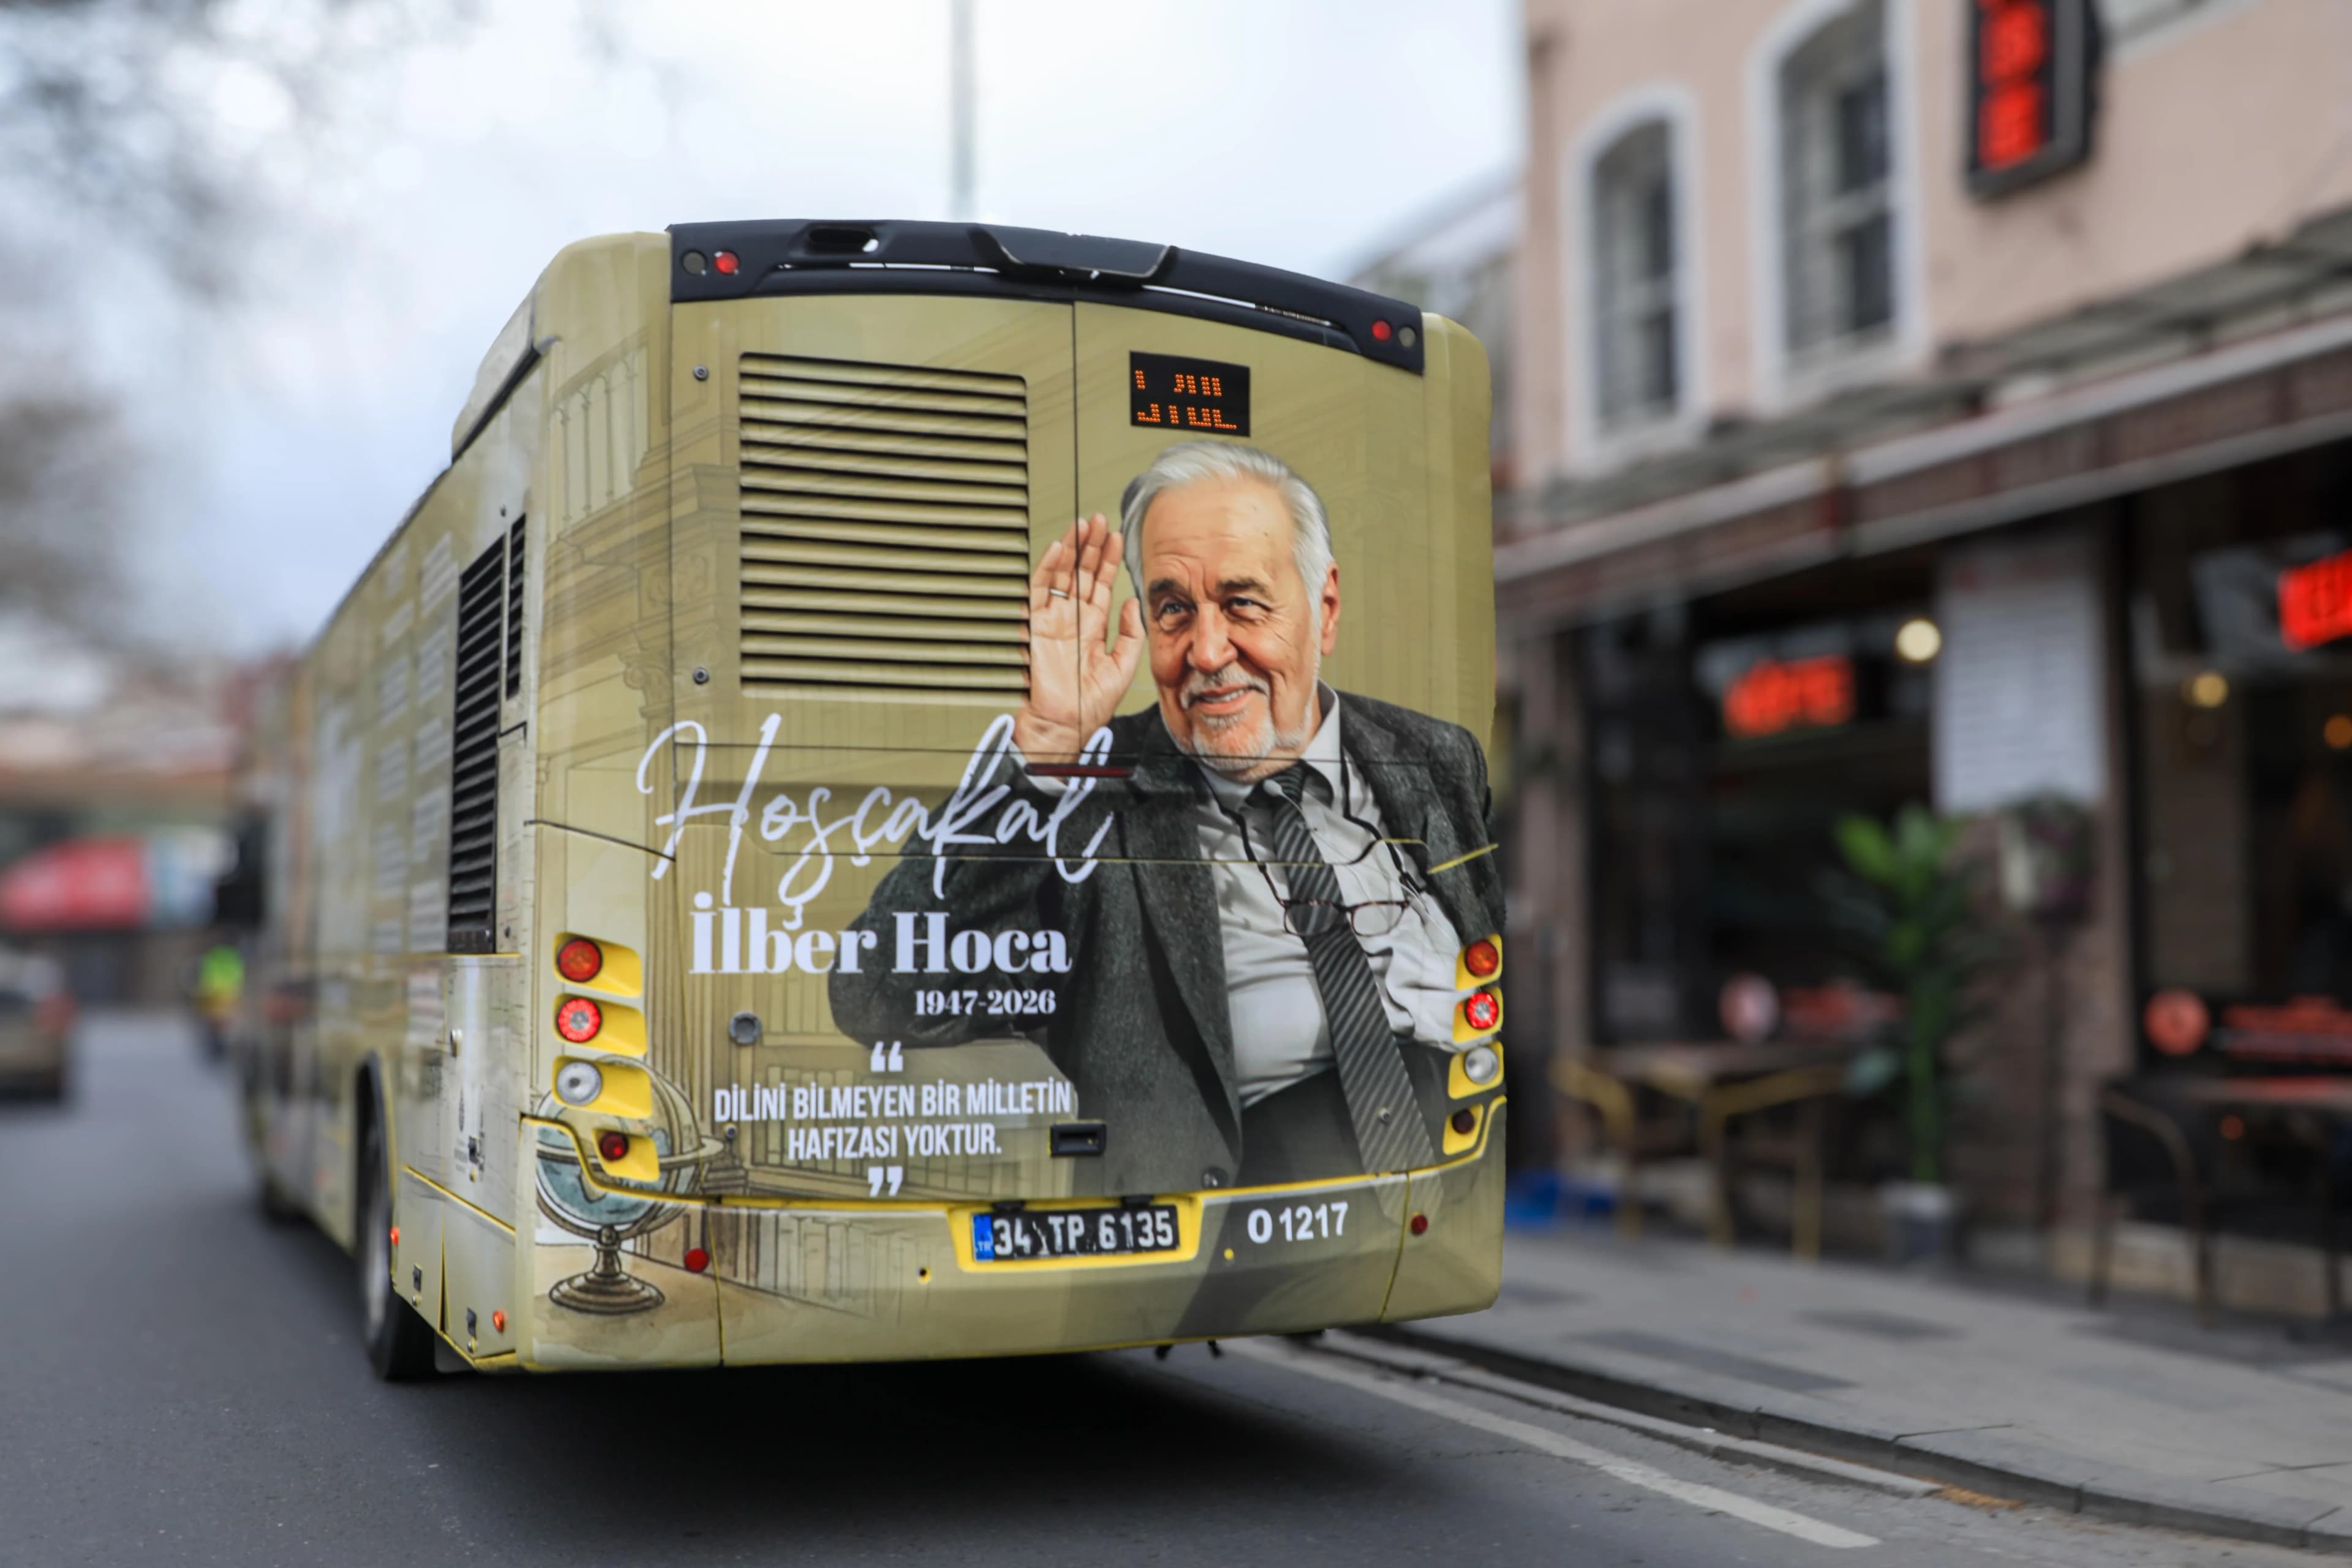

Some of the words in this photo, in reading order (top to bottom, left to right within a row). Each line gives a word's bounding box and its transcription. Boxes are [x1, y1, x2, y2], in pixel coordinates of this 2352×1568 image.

[636, 713, 1114, 930] Hoşçakal
[688, 891, 878, 974] İlber
[891, 911, 1072, 974] Hoca
[914, 989, 1057, 1017] 1947-2026
[714, 1083, 786, 1122] DİLİNİ
[793, 1081, 916, 1120] BİLMEYEN
[921, 1079, 960, 1117] BİR
[966, 1077, 1071, 1115] MİLLETİN
[788, 1128, 899, 1160] HAFIZASI
[903, 1123, 1002, 1157] YOKTUR.
[992, 1218, 1031, 1256] 34
[1047, 1215, 1085, 1253] TP
[1098, 1210, 1174, 1250] 6135
[1278, 1202, 1349, 1242] 1217
